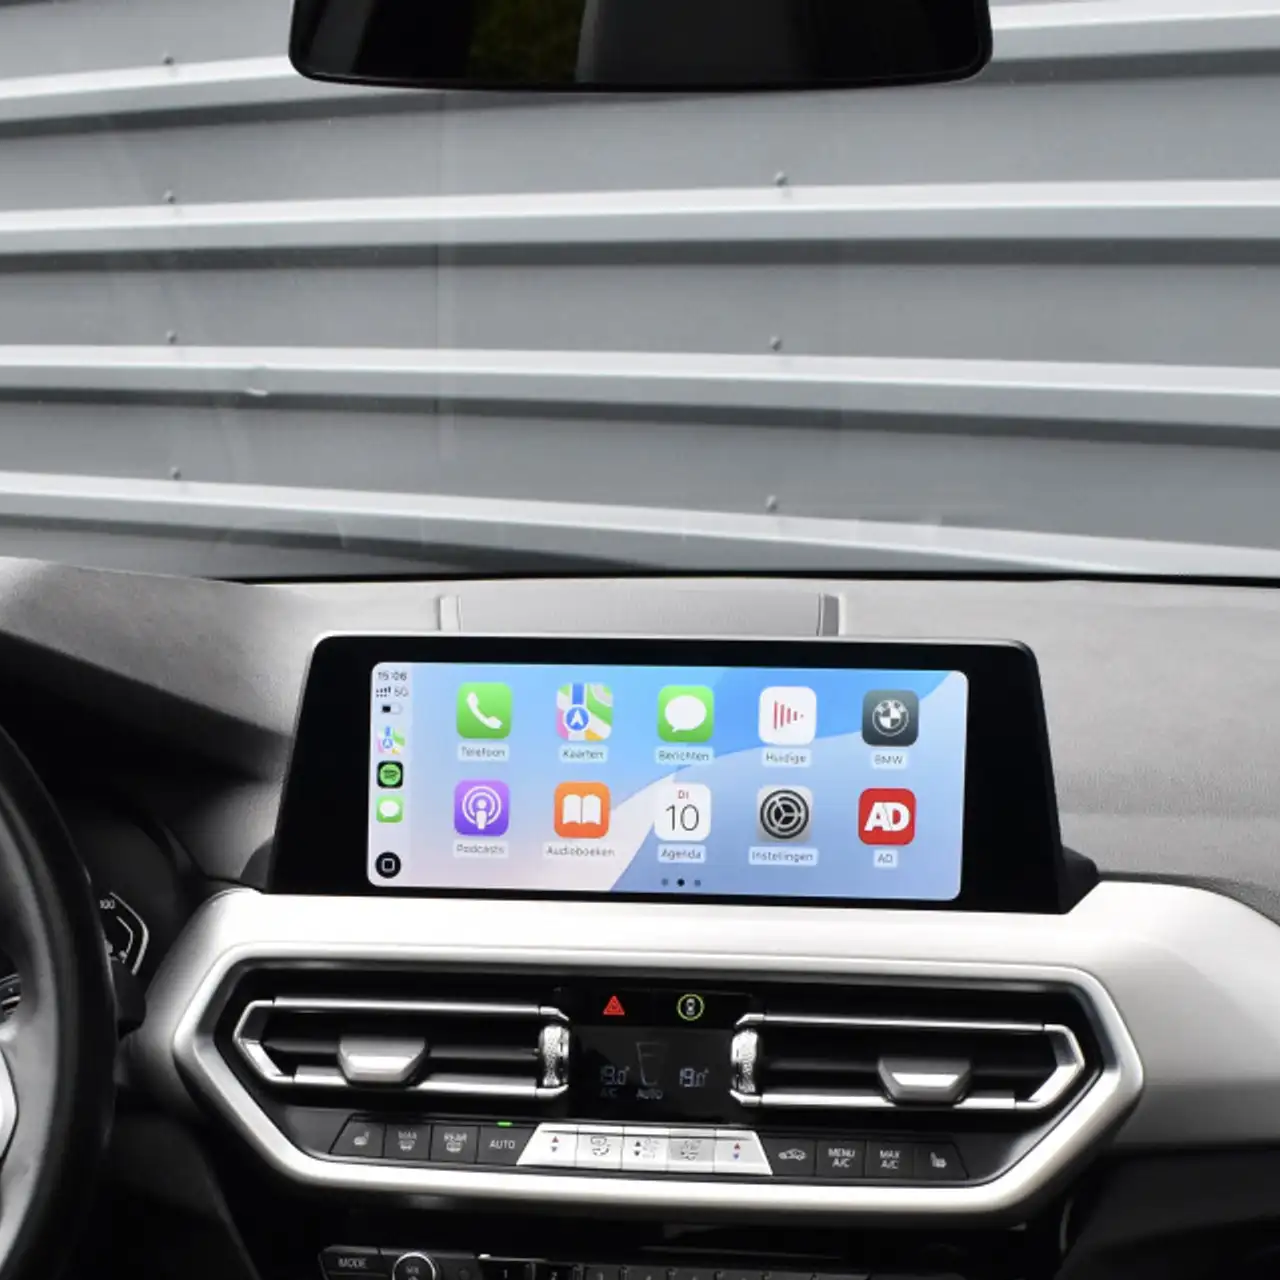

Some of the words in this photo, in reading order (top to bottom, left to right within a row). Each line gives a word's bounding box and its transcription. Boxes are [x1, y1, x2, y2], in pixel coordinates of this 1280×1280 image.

[377, 671, 408, 681] 15:06
[393, 687, 409, 697] 5G
[460, 746, 507, 758] Telefoon
[562, 749, 605, 760] Kaarten
[658, 750, 711, 762] Berichten
[765, 752, 808, 765] Huidige
[874, 754, 903, 765] BMW
[677, 789, 689, 800] DI
[665, 803, 700, 832] 10
[864, 801, 911, 832] AD
[456, 843, 506, 855] Podcasts
[545, 845, 616, 857] Audioboeken
[660, 849, 703, 861] Agenda
[751, 851, 814, 864] Instellingen
[877, 854, 894, 864] AD
[635, 1087, 664, 1100] AUTO
[489, 1139, 516, 1149] AUTO
[828, 1147, 856, 1158] MENU
[879, 1149, 900, 1160] MAX
[831, 1158, 851, 1168] A/C
[880, 1160, 899, 1170] A/C
[337, 1257, 367, 1268] MODE
